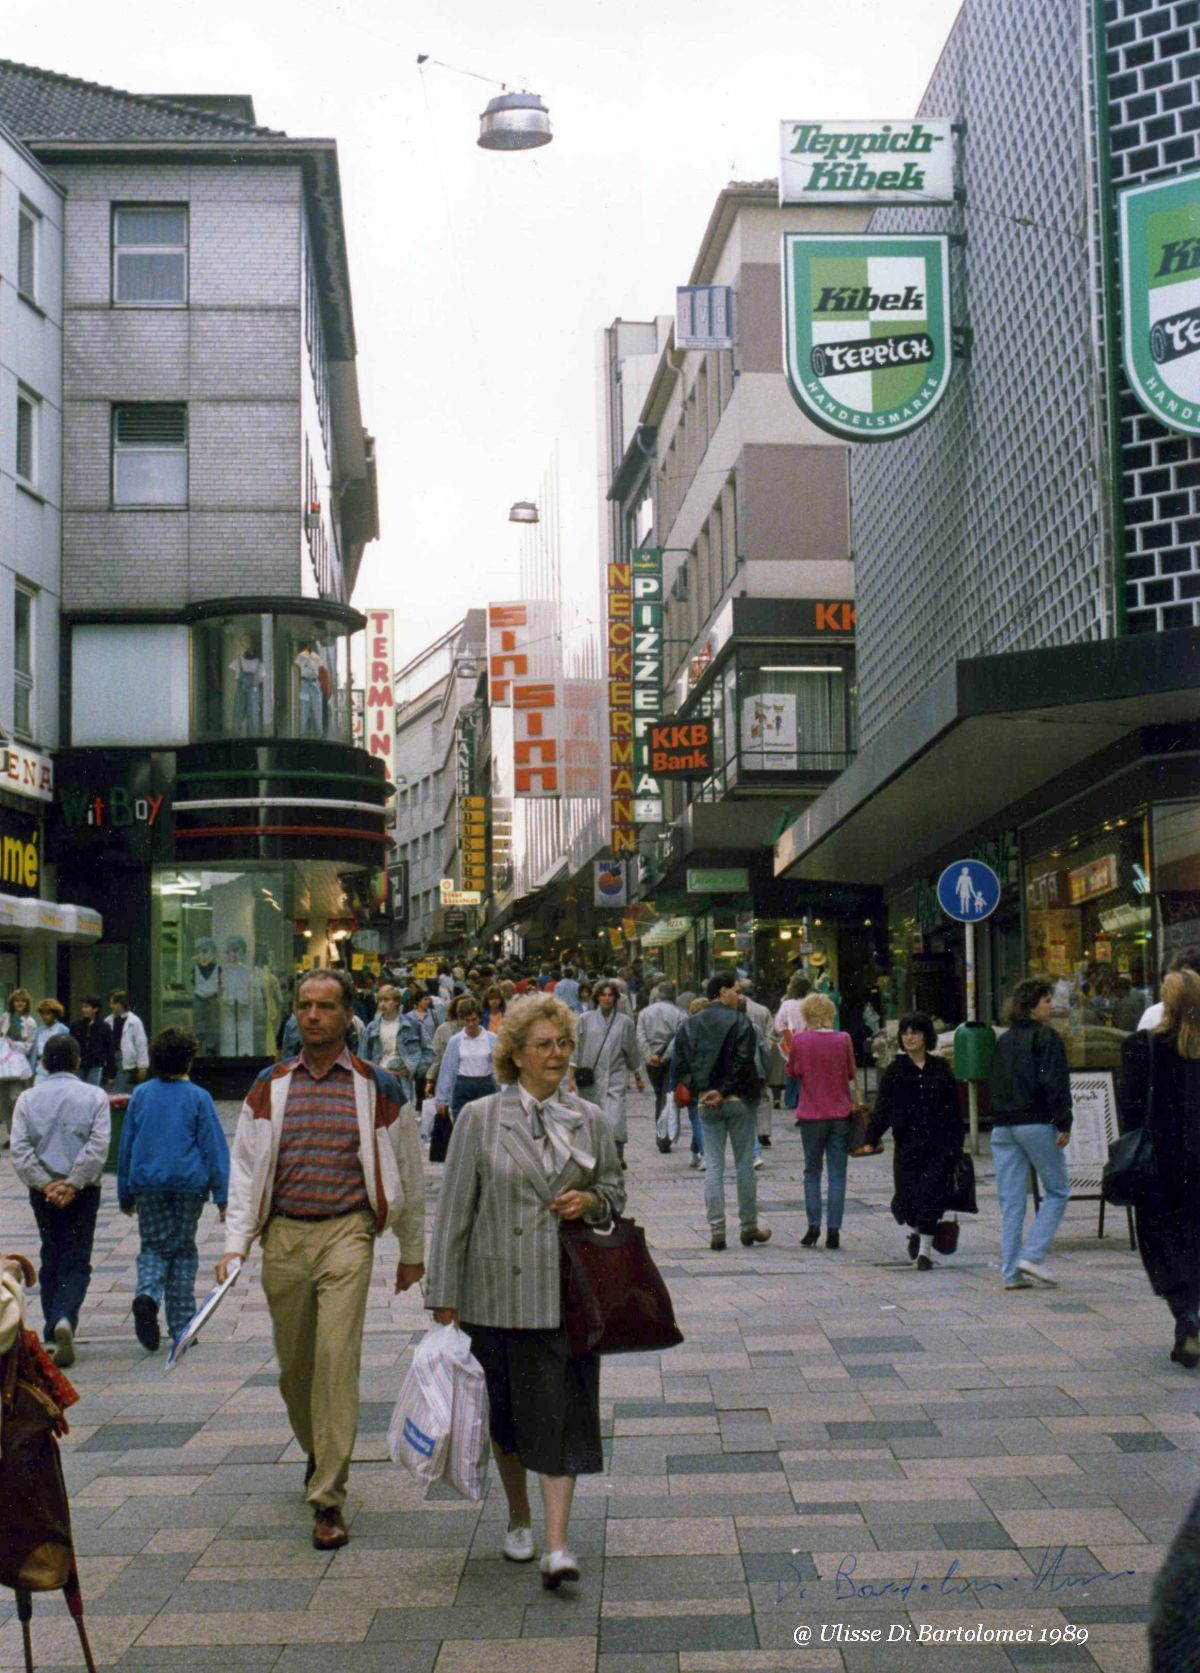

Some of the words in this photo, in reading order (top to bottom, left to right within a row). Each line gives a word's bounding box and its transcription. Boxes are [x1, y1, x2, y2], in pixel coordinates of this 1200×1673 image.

[790, 124, 944, 160] Teppich-
[803, 162, 925, 192] Kibek
[813, 286, 924, 312] Kibek
[806, 375, 938, 427] HANDELSMARKE
[634, 578, 660, 794] PIZZERIA
[609, 564, 636, 853] NECKERMANN
[652, 724, 709, 749] KKB
[652, 750, 709, 772] Bank
[463, 799, 473, 889] EDUSCHO
